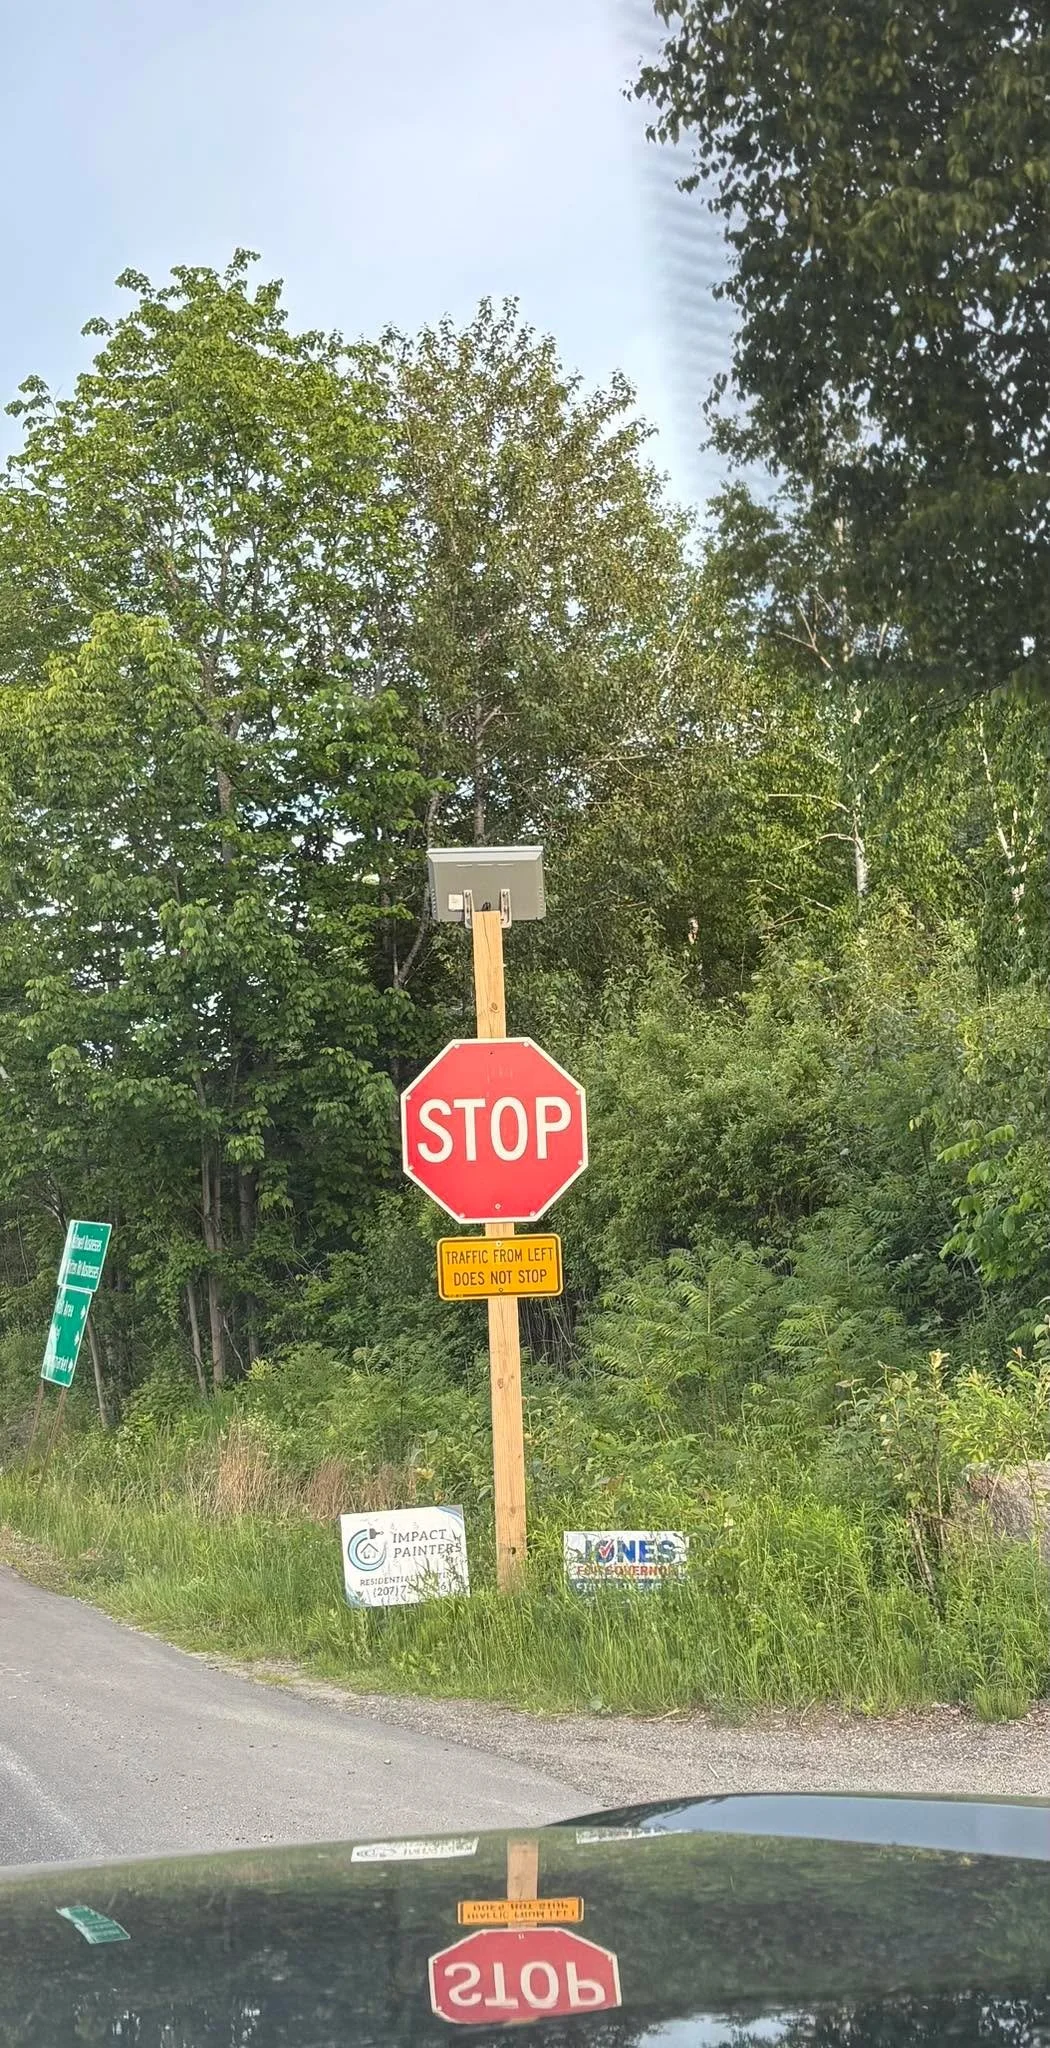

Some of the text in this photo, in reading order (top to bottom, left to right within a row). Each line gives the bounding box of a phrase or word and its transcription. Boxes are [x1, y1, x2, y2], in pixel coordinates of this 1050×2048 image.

[417, 1096, 572, 1163] STOP
[446, 1247, 554, 1264] TRAFFIC FROM LEFT
[453, 1269, 548, 1286] DOES NOT STOP
[393, 1528, 447, 1544] IMPACT
[394, 1543, 462, 1558] PAINTERS
[579, 1539, 676, 1563] JONES
